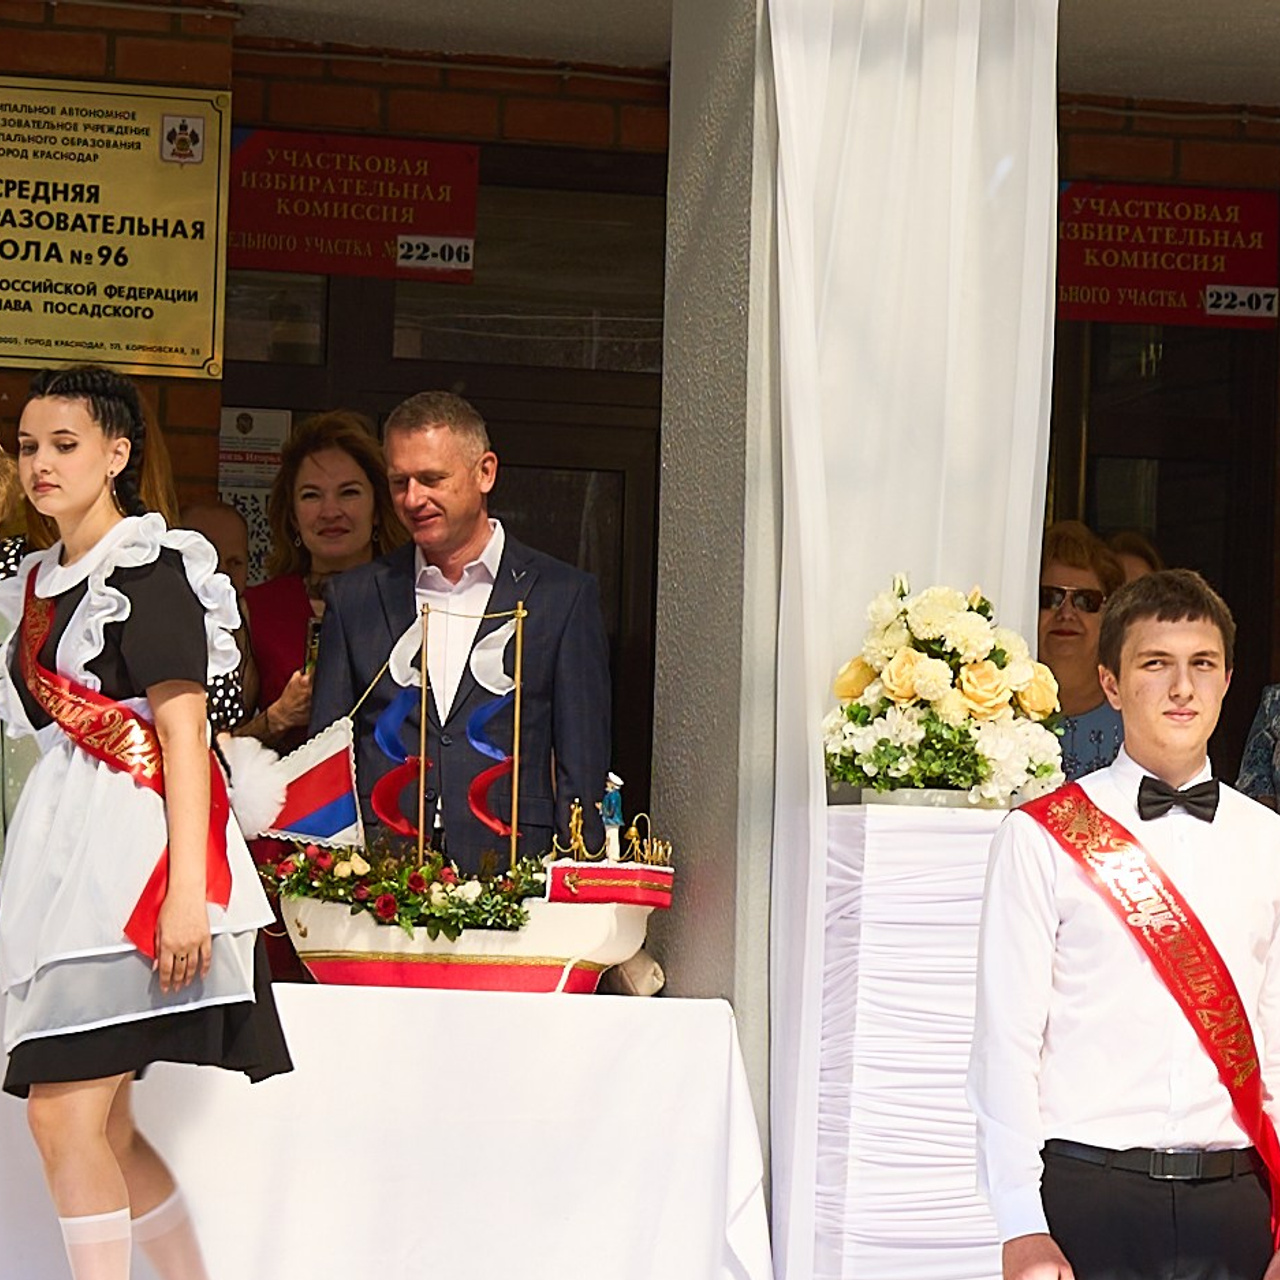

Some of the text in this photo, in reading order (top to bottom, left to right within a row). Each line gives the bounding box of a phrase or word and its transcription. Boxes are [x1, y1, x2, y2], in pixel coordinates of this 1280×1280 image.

[60, 106, 137, 121] АВТОНОМНОЕ
[83, 122, 150, 137] УЧРЕЖДЕНИЕ
[61, 136, 141, 150] ОБРАЗОВАНИЯ
[33, 150, 99, 163] КРАСНОДАР
[266, 148, 430, 177] УЧАСТКОВАЯ
[0, 179, 100, 204] РЕДНЯЯ
[240, 171, 452, 203] ИЗБИРАТЕЛЬНАЯ
[276, 199, 415, 224] КОМИССИЯ
[1072, 197, 1241, 223] УЧАСТКОВАЯ
[0, 208, 205, 240] АЗОВАТЕЛЬНАЯ
[0, 238, 64, 264] ОЛА
[305, 237, 373, 257] УЧАСТКА
[400, 241, 471, 264] 22-06
[1084, 248, 1226, 273] КОМИССИЯ
[0, 278, 199, 303] ОССИЙСКОЙ ФЕДЕРАЦИИ
[1117, 287, 1188, 308] УЧАСТКА
[0, 298, 154, 320] АВА ПОСАДСКОГО
[1088, 837, 1257, 1088] Выпускник 2024
